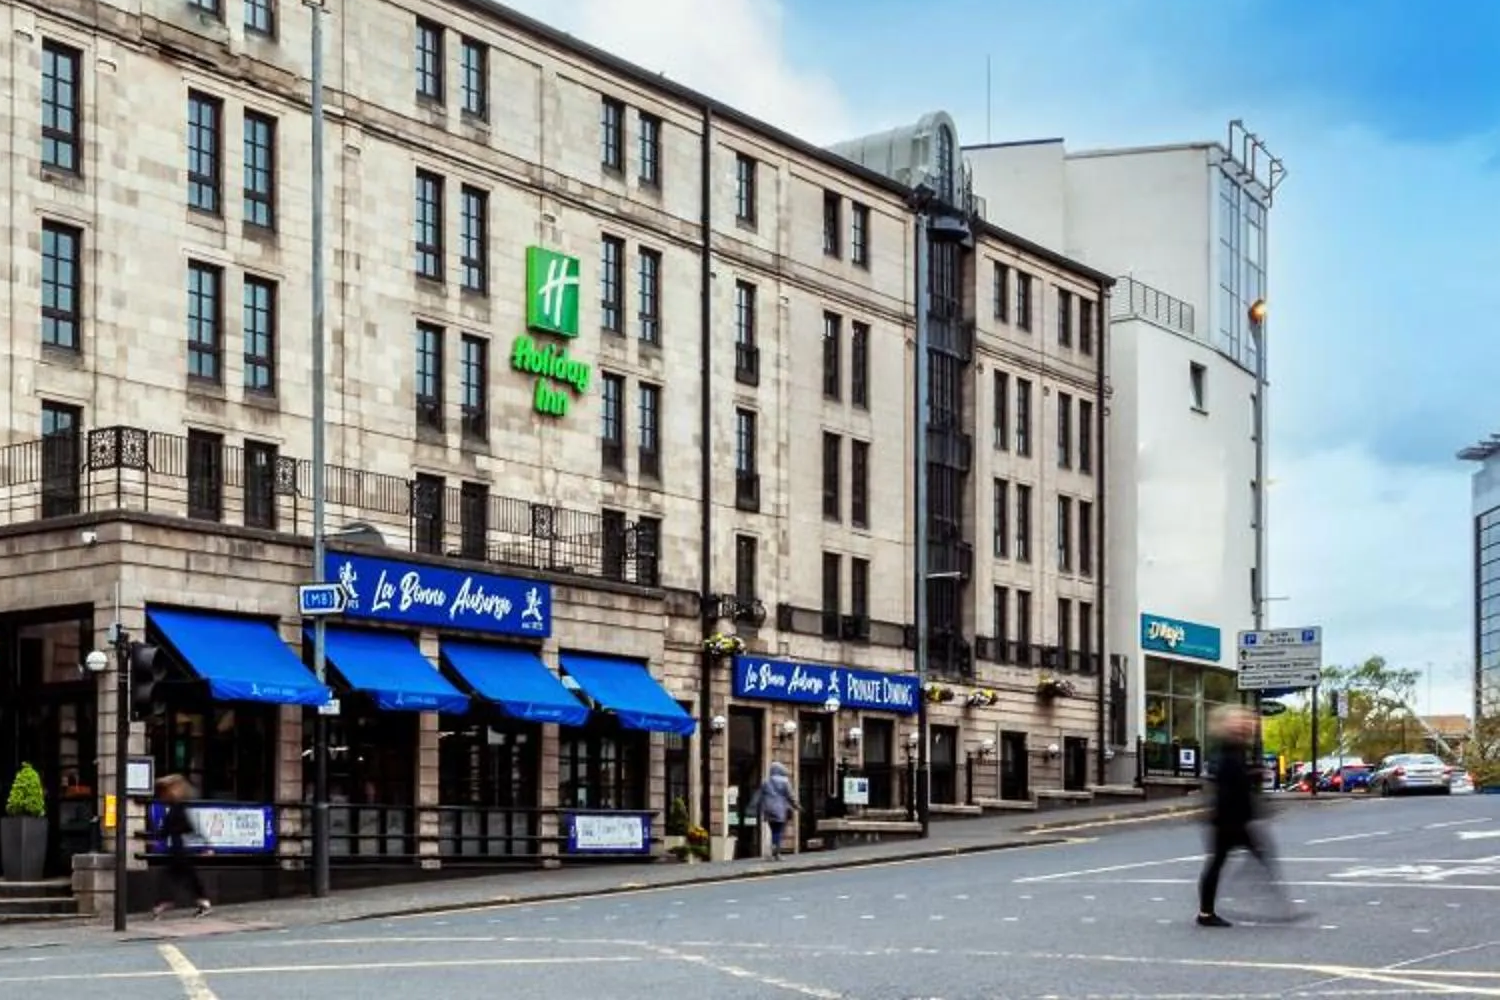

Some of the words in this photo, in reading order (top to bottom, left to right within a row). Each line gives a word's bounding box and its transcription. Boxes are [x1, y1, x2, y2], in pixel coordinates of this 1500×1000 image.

[511, 335, 590, 394] Holiday
[535, 377, 568, 416] Inn
[372, 569, 396, 612] La
[400, 571, 446, 611] Bonne
[449, 576, 512, 621] Auberge
